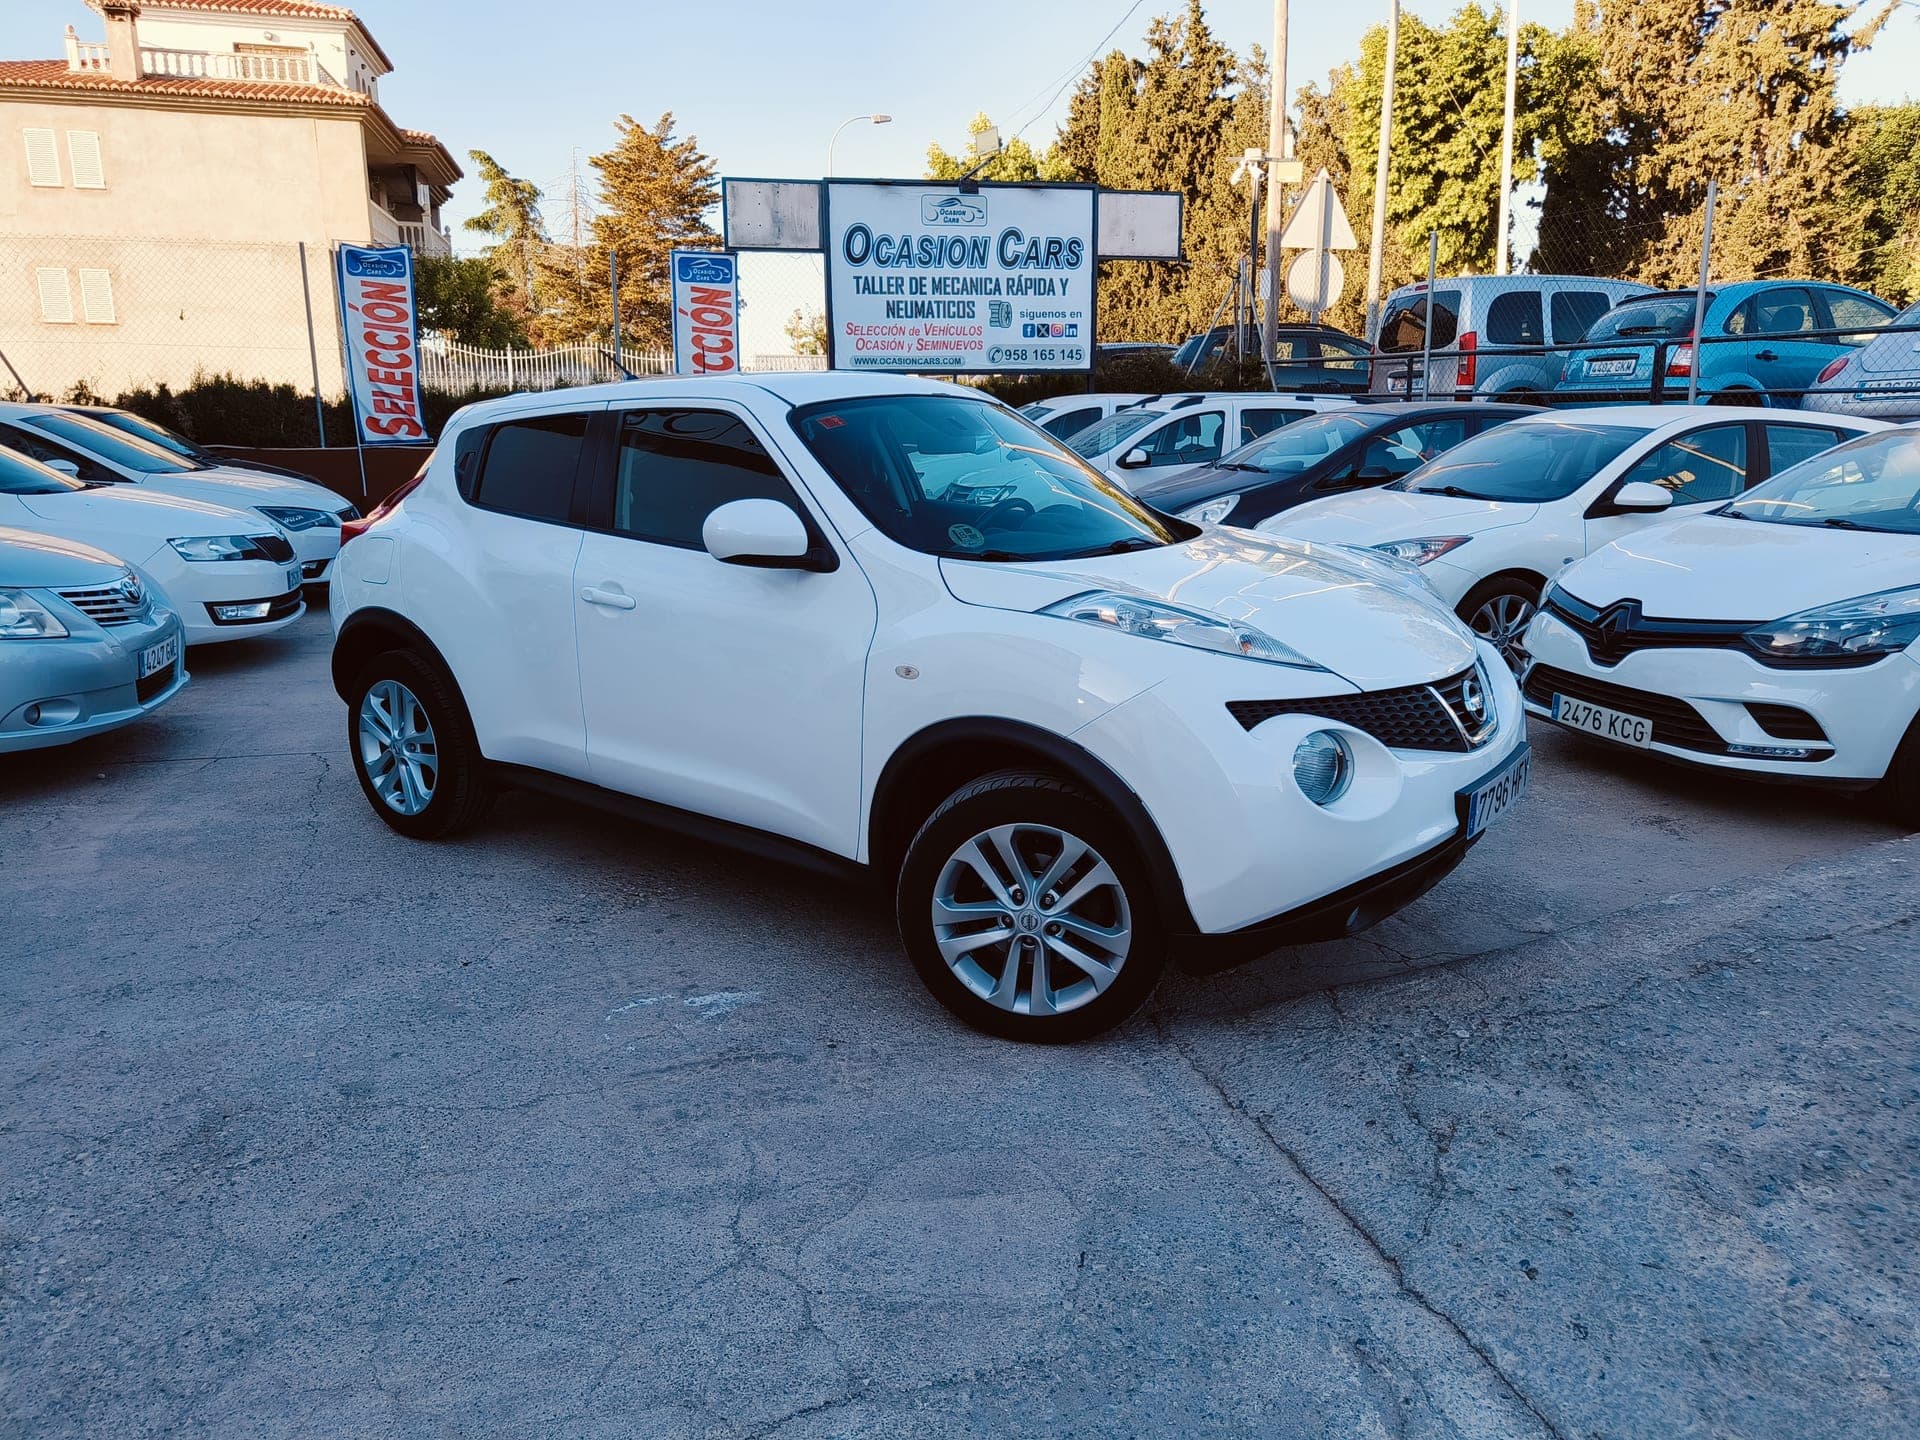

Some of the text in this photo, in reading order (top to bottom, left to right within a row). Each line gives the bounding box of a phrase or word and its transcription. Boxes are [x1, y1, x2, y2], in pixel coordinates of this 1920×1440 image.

[853, 275, 1069, 296] TALLER DE MECANICA RÁPIDA Y
[886, 300, 975, 319] NEUMATICOS
[1019, 309, 1067, 320] siguenos
[678, 286, 734, 374] CCIÓN
[908, 326, 920, 337] de
[348, 280, 422, 436] SELECCIÓN
[907, 343, 912, 353] y
[1005, 349, 1082, 361] 958 165 145
[854, 357, 961, 365] WWW.OCASIONCARS.COM
[146, 645, 165, 670] 4247
[1562, 701, 1645, 742] 2476 KCG
[1478, 775, 1510, 827] 7796
